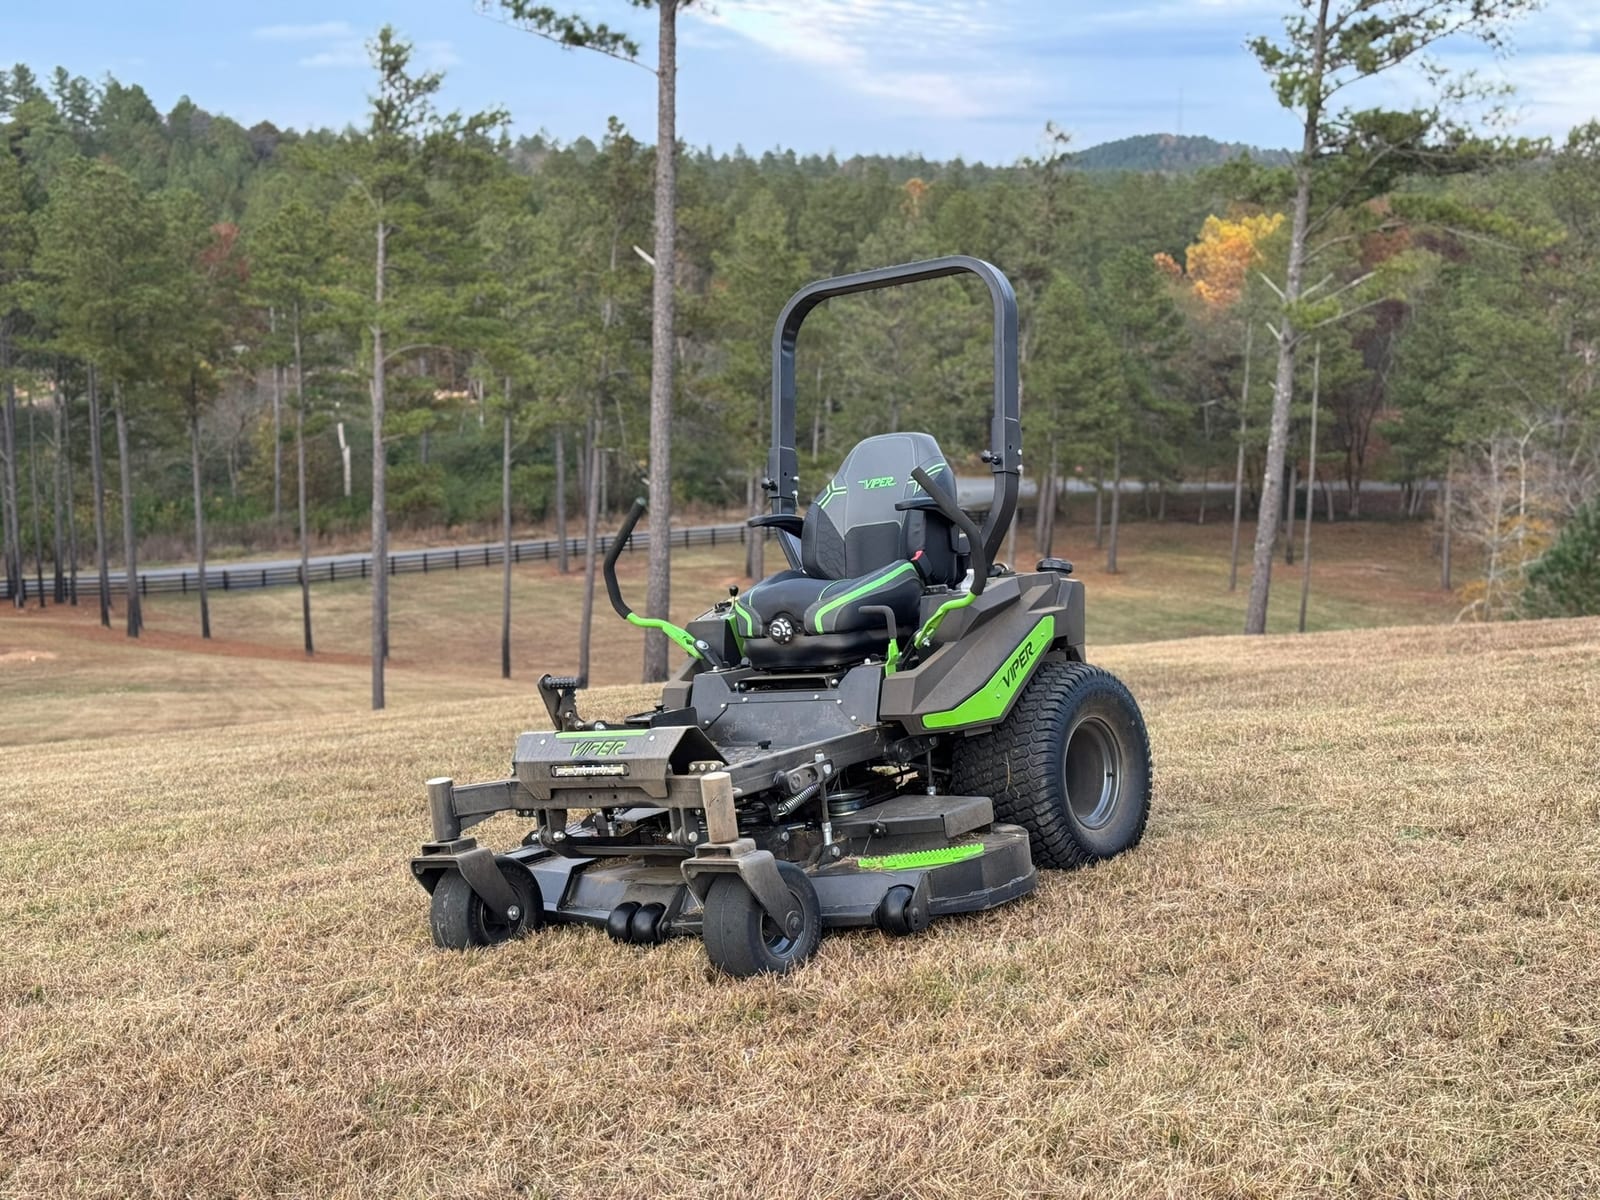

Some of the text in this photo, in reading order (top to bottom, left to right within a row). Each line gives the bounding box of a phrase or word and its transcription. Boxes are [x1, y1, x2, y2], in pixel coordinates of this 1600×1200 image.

[860, 475, 897, 490] VIPER
[1000, 641, 1036, 689] VIPER
[568, 740, 628, 757] VIPER
